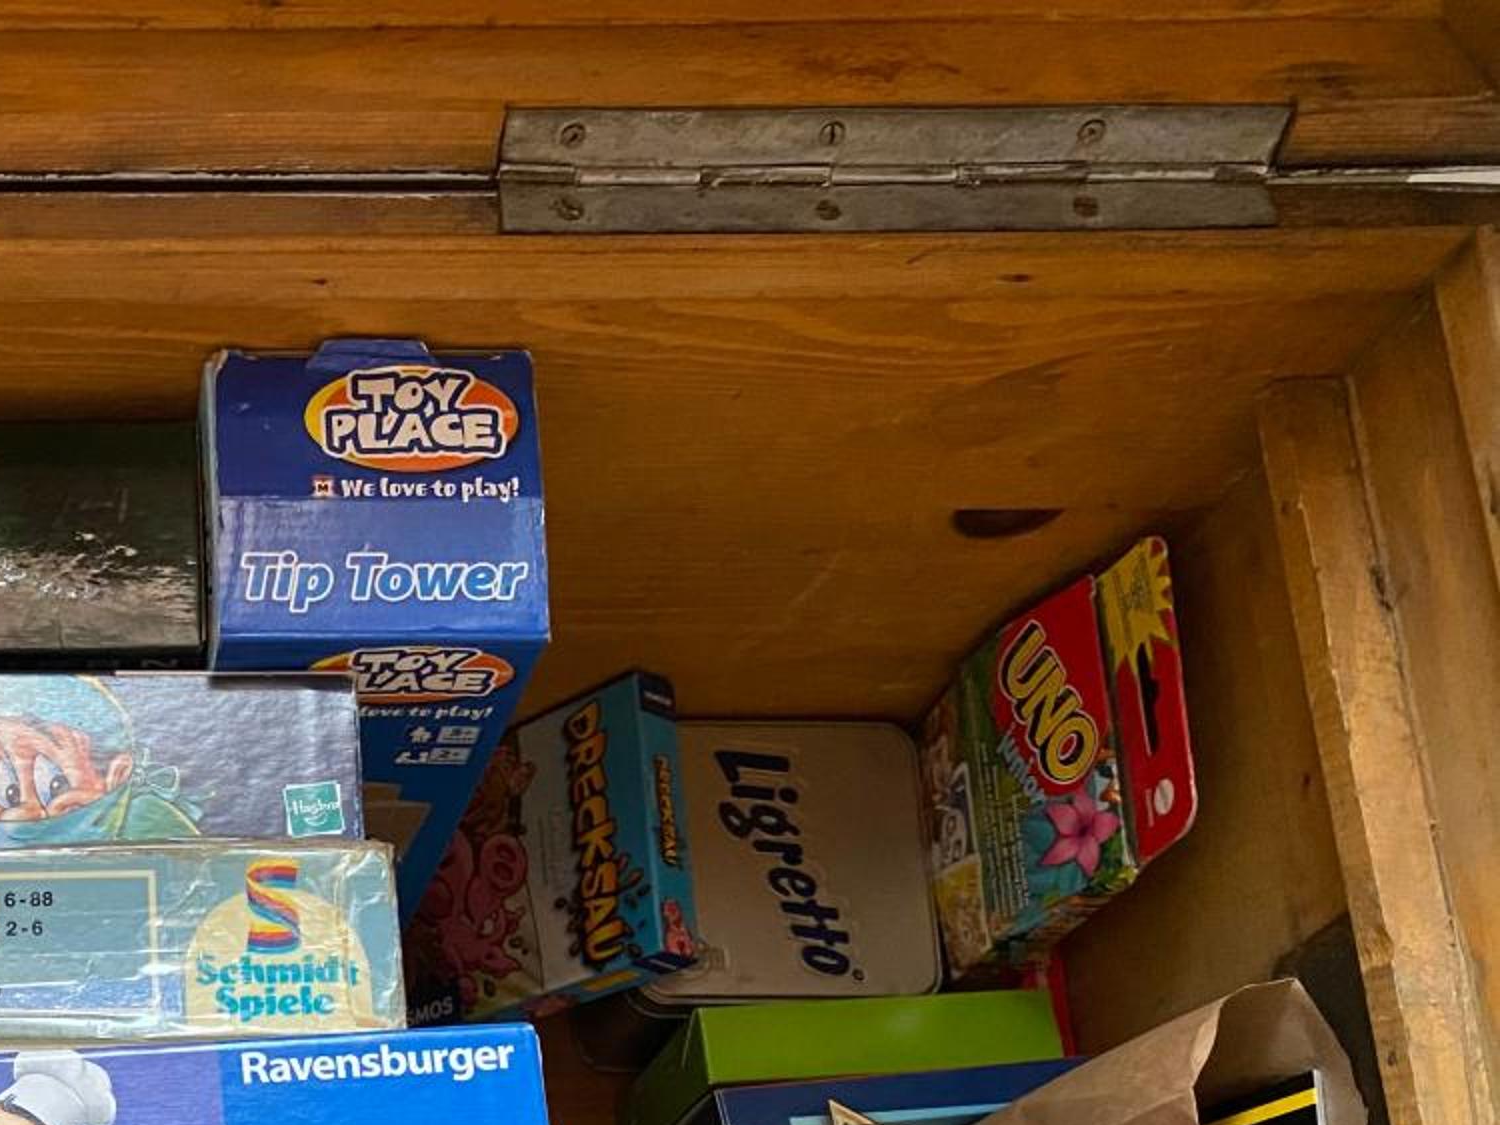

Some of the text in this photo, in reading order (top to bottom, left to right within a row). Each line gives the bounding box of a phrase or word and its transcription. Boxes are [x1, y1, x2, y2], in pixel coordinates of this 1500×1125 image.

[353, 371, 468, 412] TOY
[329, 402, 502, 455] PLACE
[341, 477, 519, 503] We love to play!
[242, 552, 528, 612] Tip Tower
[358, 651, 468, 674] TOY
[358, 671, 488, 693] LACE
[998, 619, 1098, 786] UNO
[563, 702, 623, 963] DRECKSAU
[198, 956, 360, 987] Schmidt
[216, 989, 336, 1021] Spiele
[405, 996, 454, 1025] SMOS
[240, 1043, 515, 1086] Ravensburger
